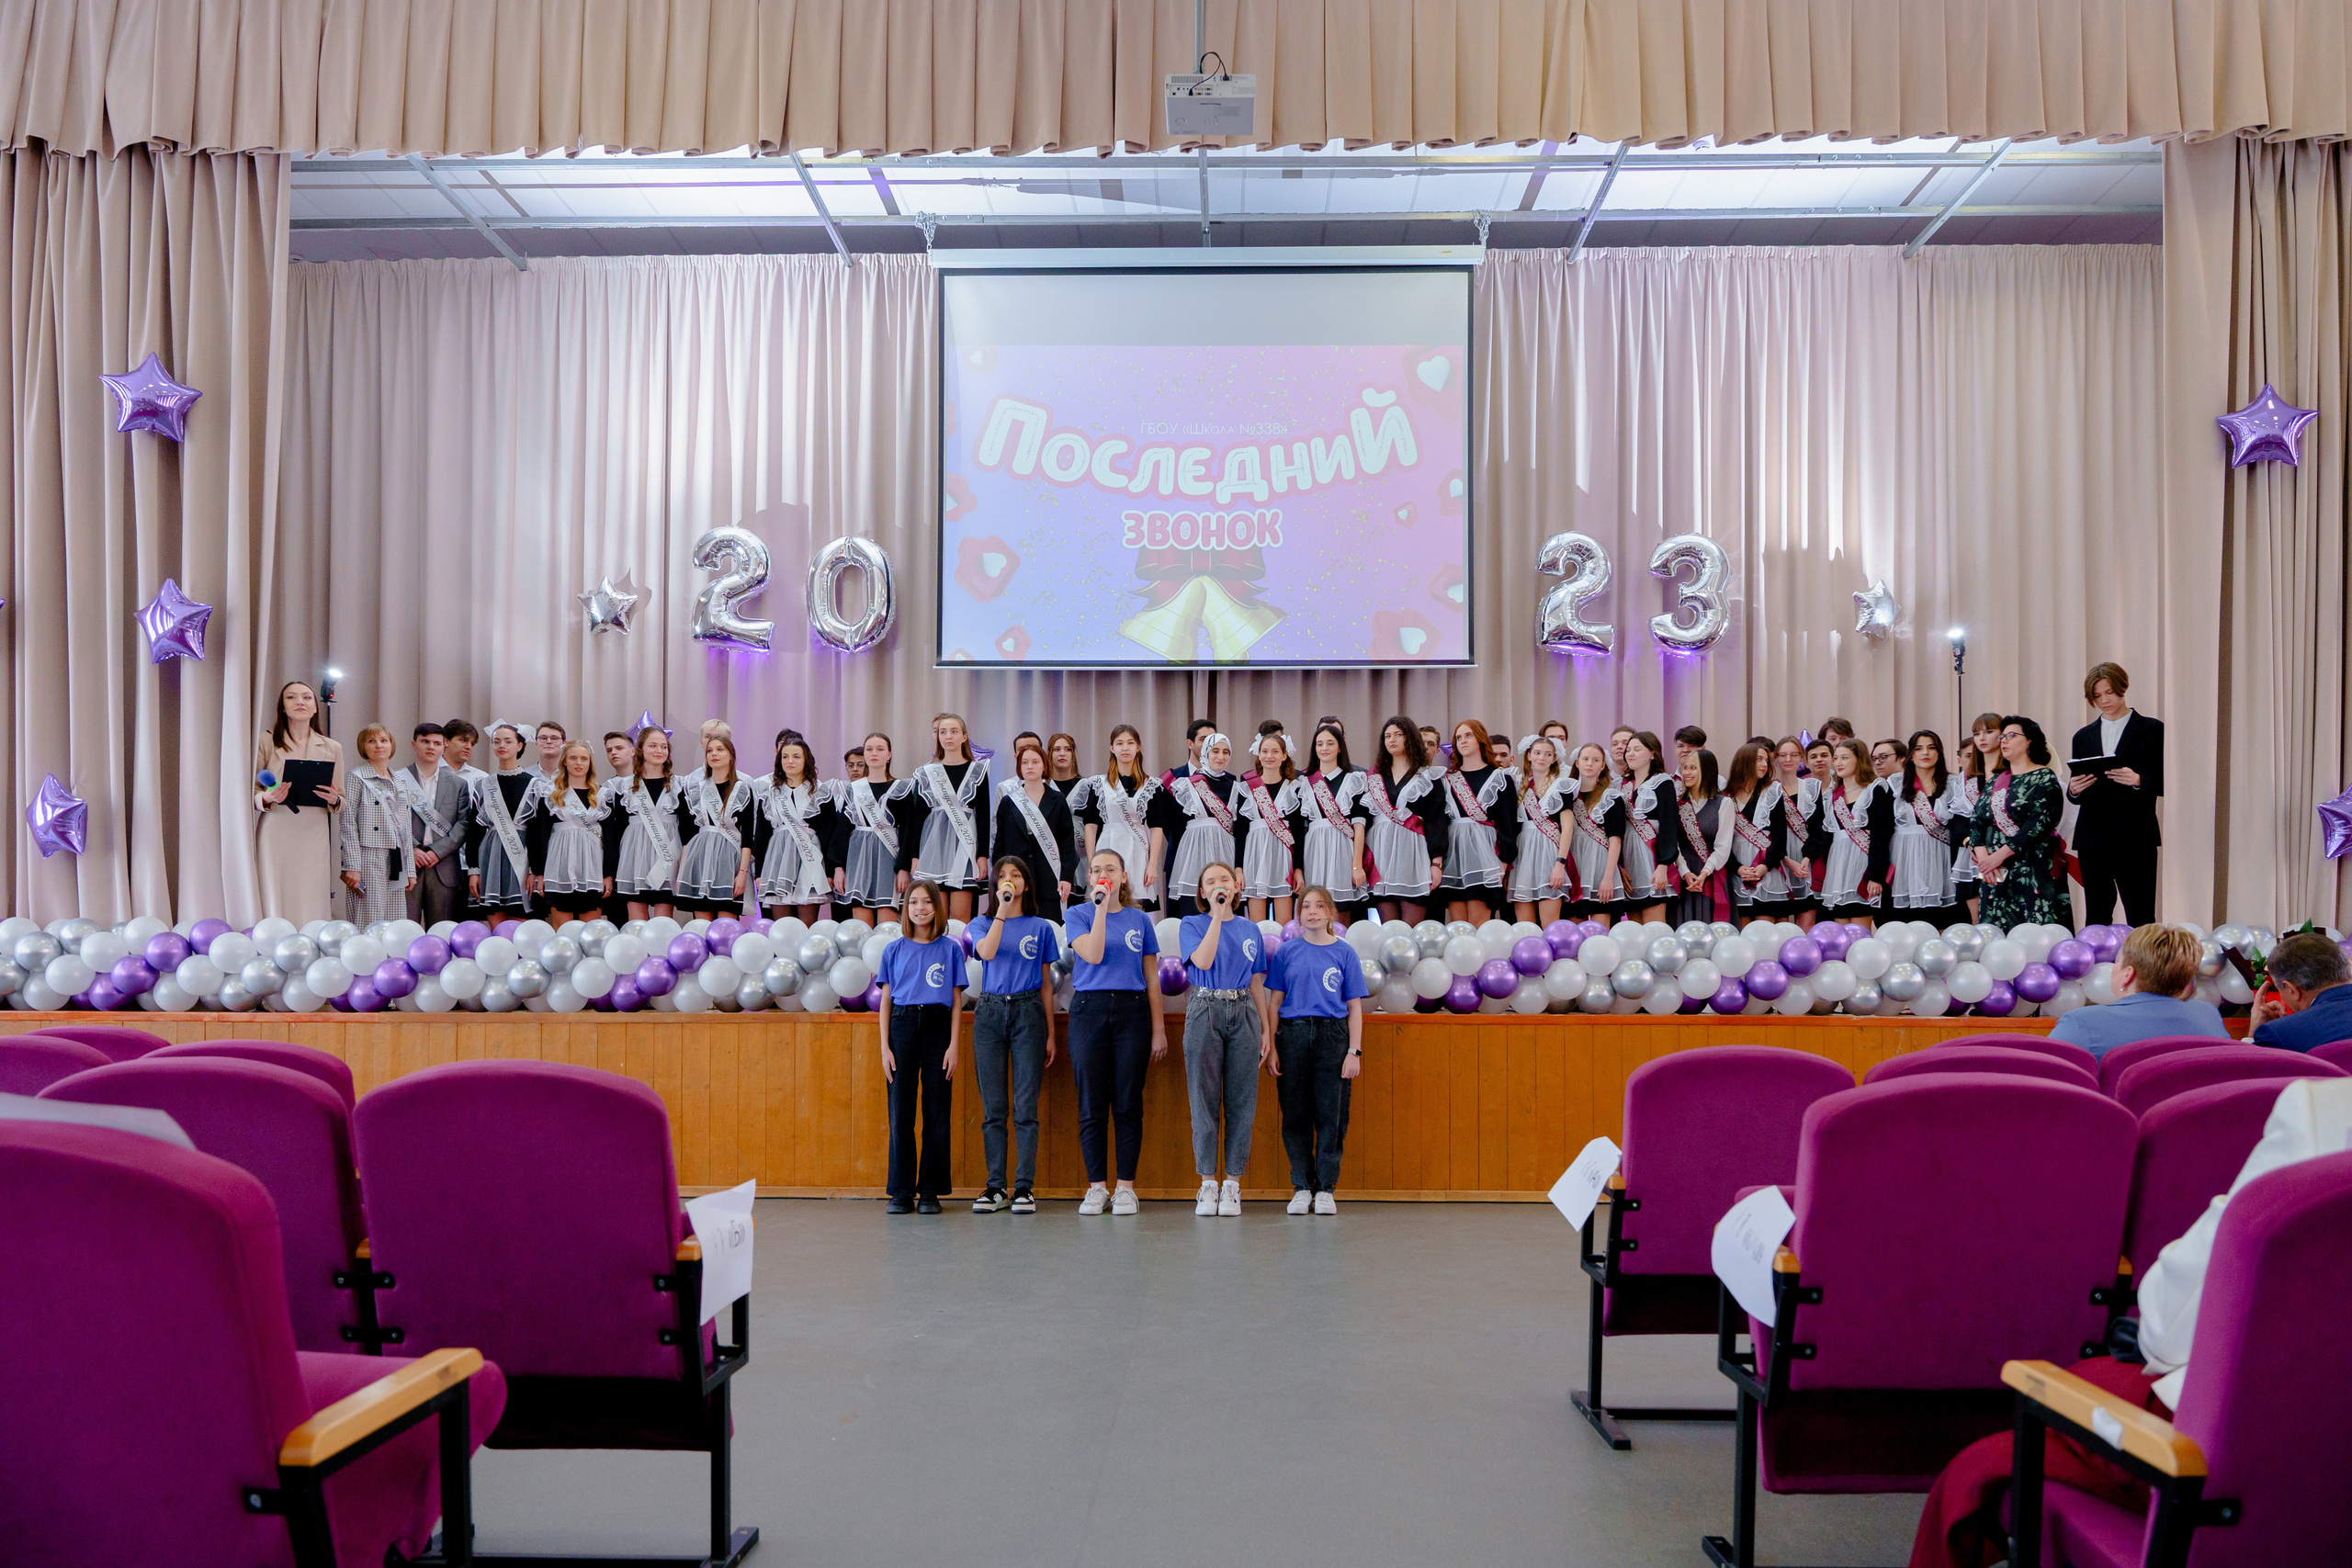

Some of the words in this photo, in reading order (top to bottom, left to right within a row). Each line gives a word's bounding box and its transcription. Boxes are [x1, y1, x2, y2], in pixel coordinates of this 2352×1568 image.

[1140, 422, 1178, 434] ГБОУ
[1239, 422, 1287, 434] №338»
[1123, 509, 1283, 549] ЗВОНОК
[488, 785, 509, 836] Выпускница
[506, 836, 521, 855] 2023
[636, 793, 663, 843] Выпускница
[659, 843, 673, 863] 2023
[777, 795, 805, 842] Выпускница
[801, 843, 815, 863] 2023
[936, 777, 963, 827] Выпускница
[959, 828, 975, 846] 2023
[1019, 796, 1047, 842] Выпускница
[1043, 840, 1059, 862] 2023
